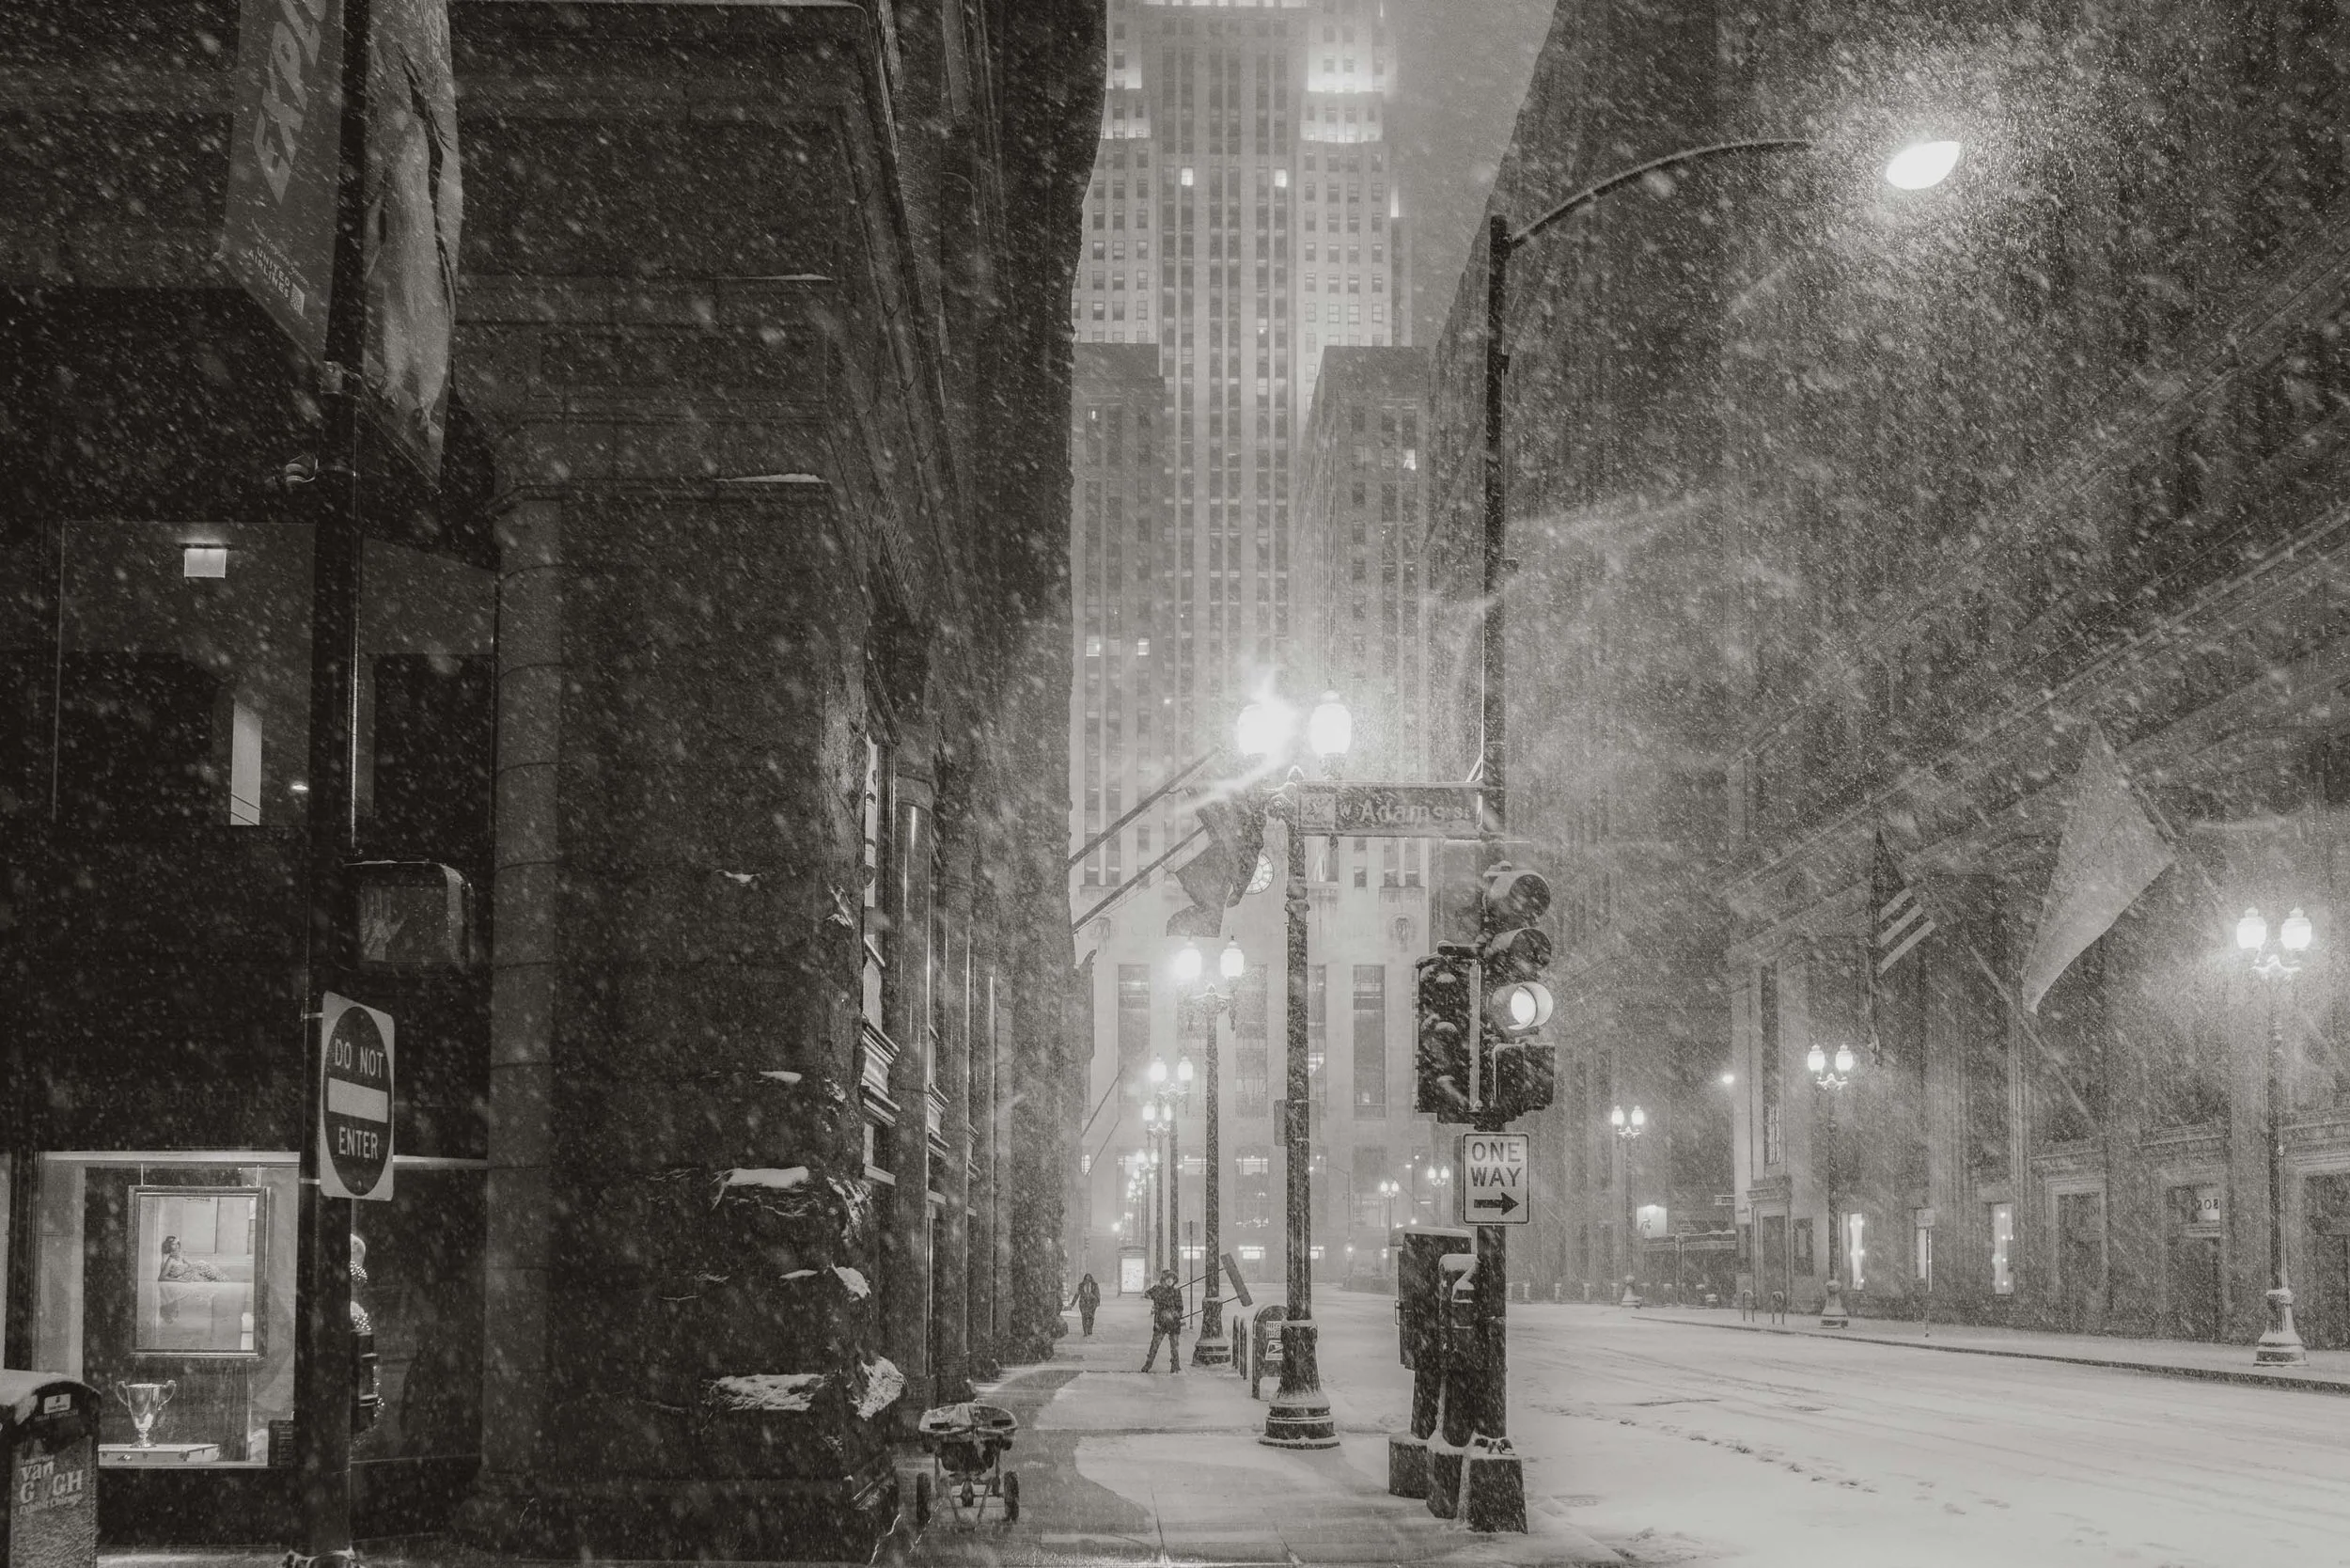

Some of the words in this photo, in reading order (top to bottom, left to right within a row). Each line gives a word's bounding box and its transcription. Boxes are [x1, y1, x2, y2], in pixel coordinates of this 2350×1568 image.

[253, 0, 326, 205] EXPL
[248, 249, 290, 298] AIRLINES
[257, 245, 290, 288] UNITED
[1359, 799, 1445, 823] Adams
[335, 1038, 352, 1070] DO
[359, 1045, 384, 1079] NOT
[338, 1126, 379, 1160] ENTER
[1471, 1141, 1522, 1163] ONE
[1470, 1167, 1522, 1187] WAY
